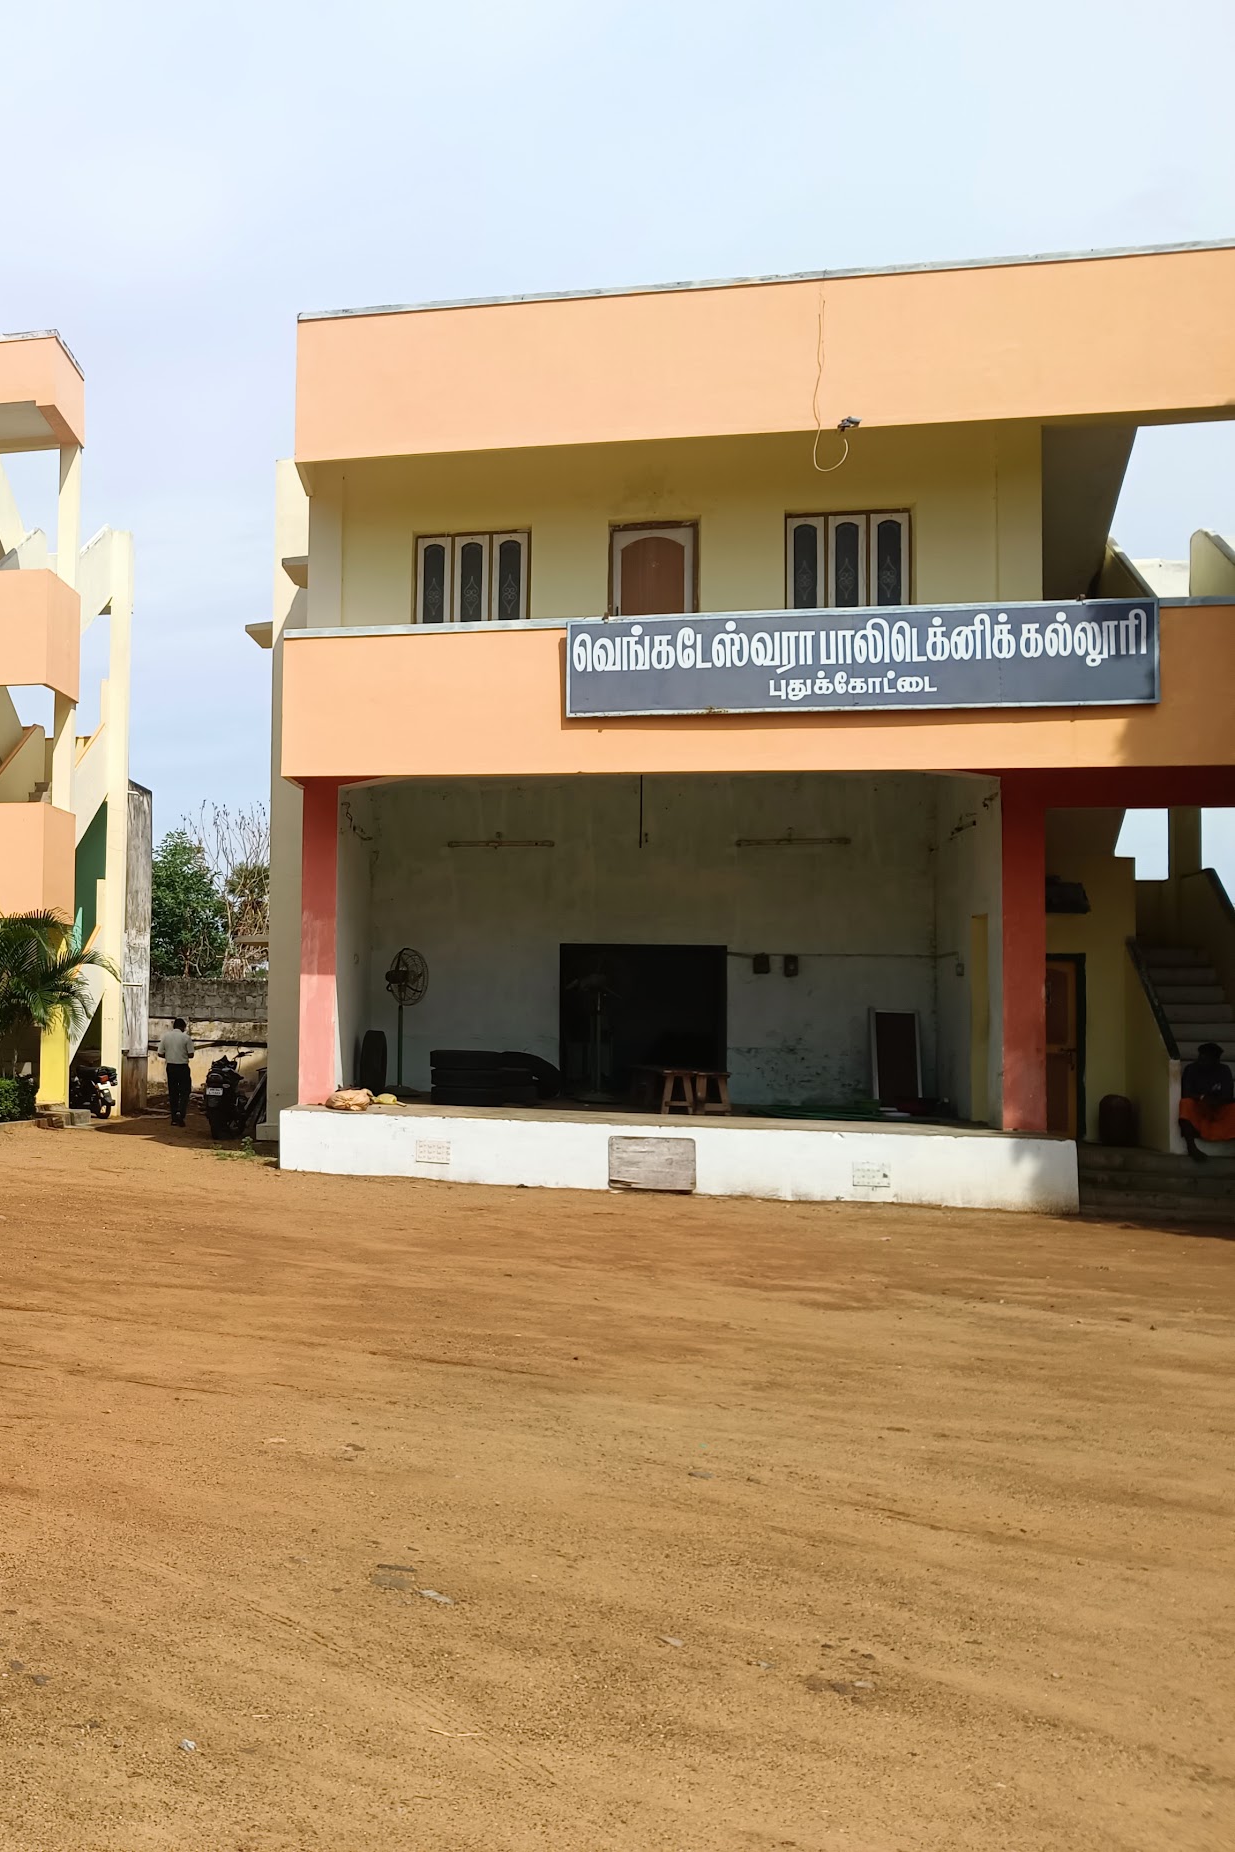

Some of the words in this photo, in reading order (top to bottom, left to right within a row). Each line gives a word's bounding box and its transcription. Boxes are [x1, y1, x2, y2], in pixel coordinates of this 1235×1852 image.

[572, 620, 816, 674] வெங்கடேஸ்வரா
[819, 612, 1016, 665] பாலிடெக்னிக்
[1019, 609, 1147, 667] கல்லூரி
[769, 670, 937, 700] புதுக்கோட்டை
